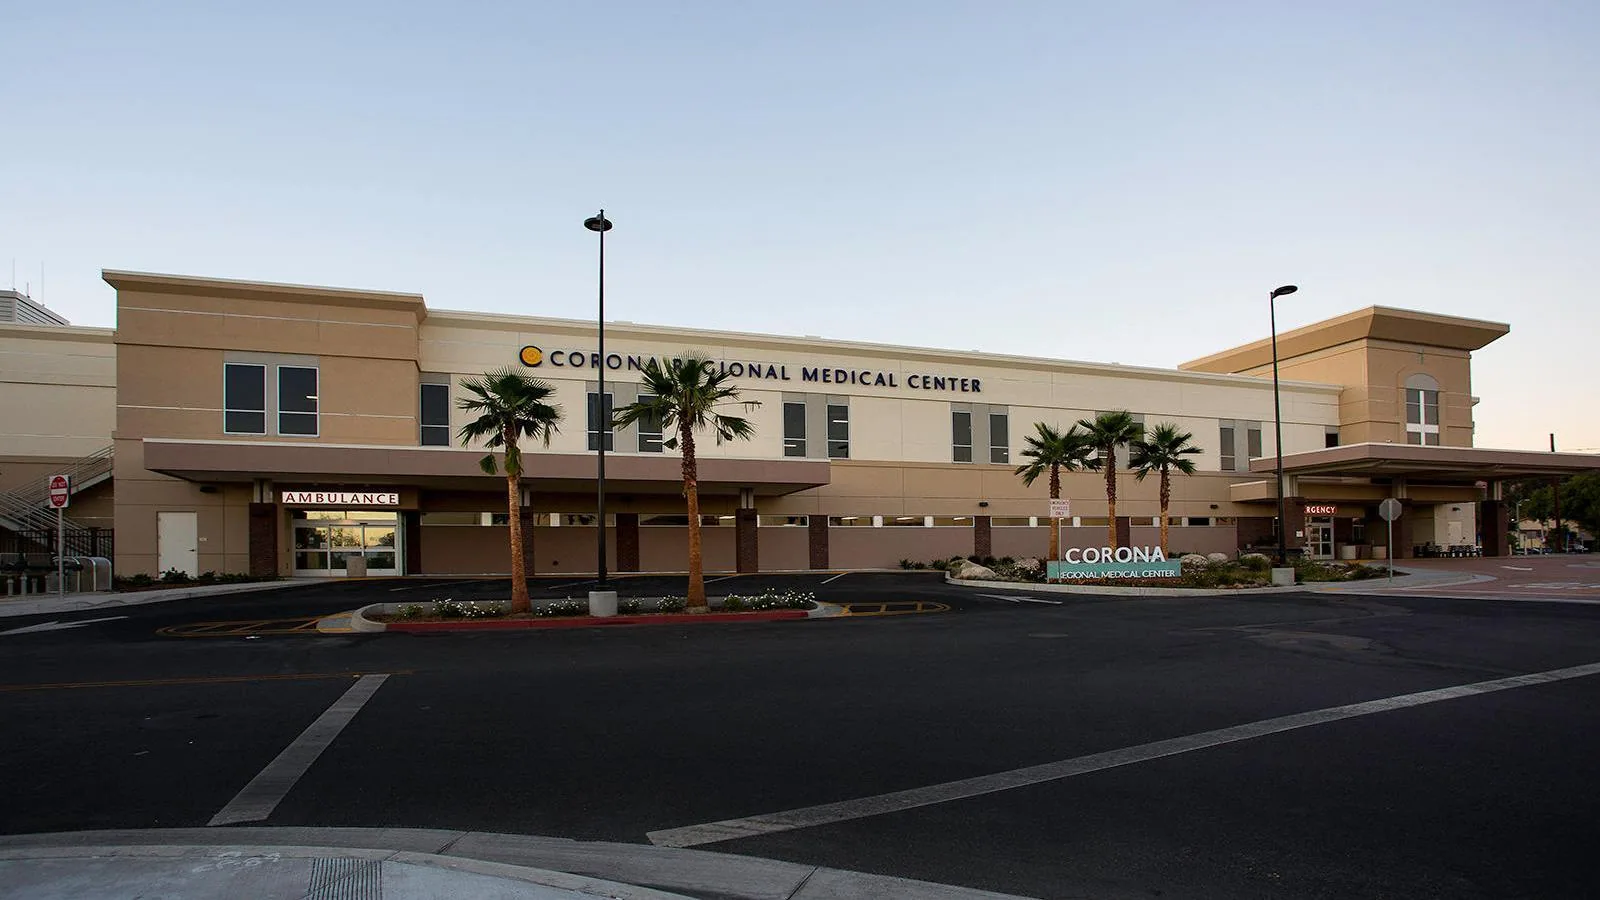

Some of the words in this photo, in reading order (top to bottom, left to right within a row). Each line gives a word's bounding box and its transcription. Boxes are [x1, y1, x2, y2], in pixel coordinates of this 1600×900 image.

[550, 351, 661, 372] CORONA
[802, 367, 898, 387] MEDICAL
[907, 375, 981, 392] CENTER
[286, 493, 396, 504] AMBULANCE
[1305, 506, 1336, 514] RGENCY
[1065, 546, 1166, 564] CORONA
[1101, 570, 1140, 579] MEDICAL
[1142, 569, 1176, 578] CENTER
